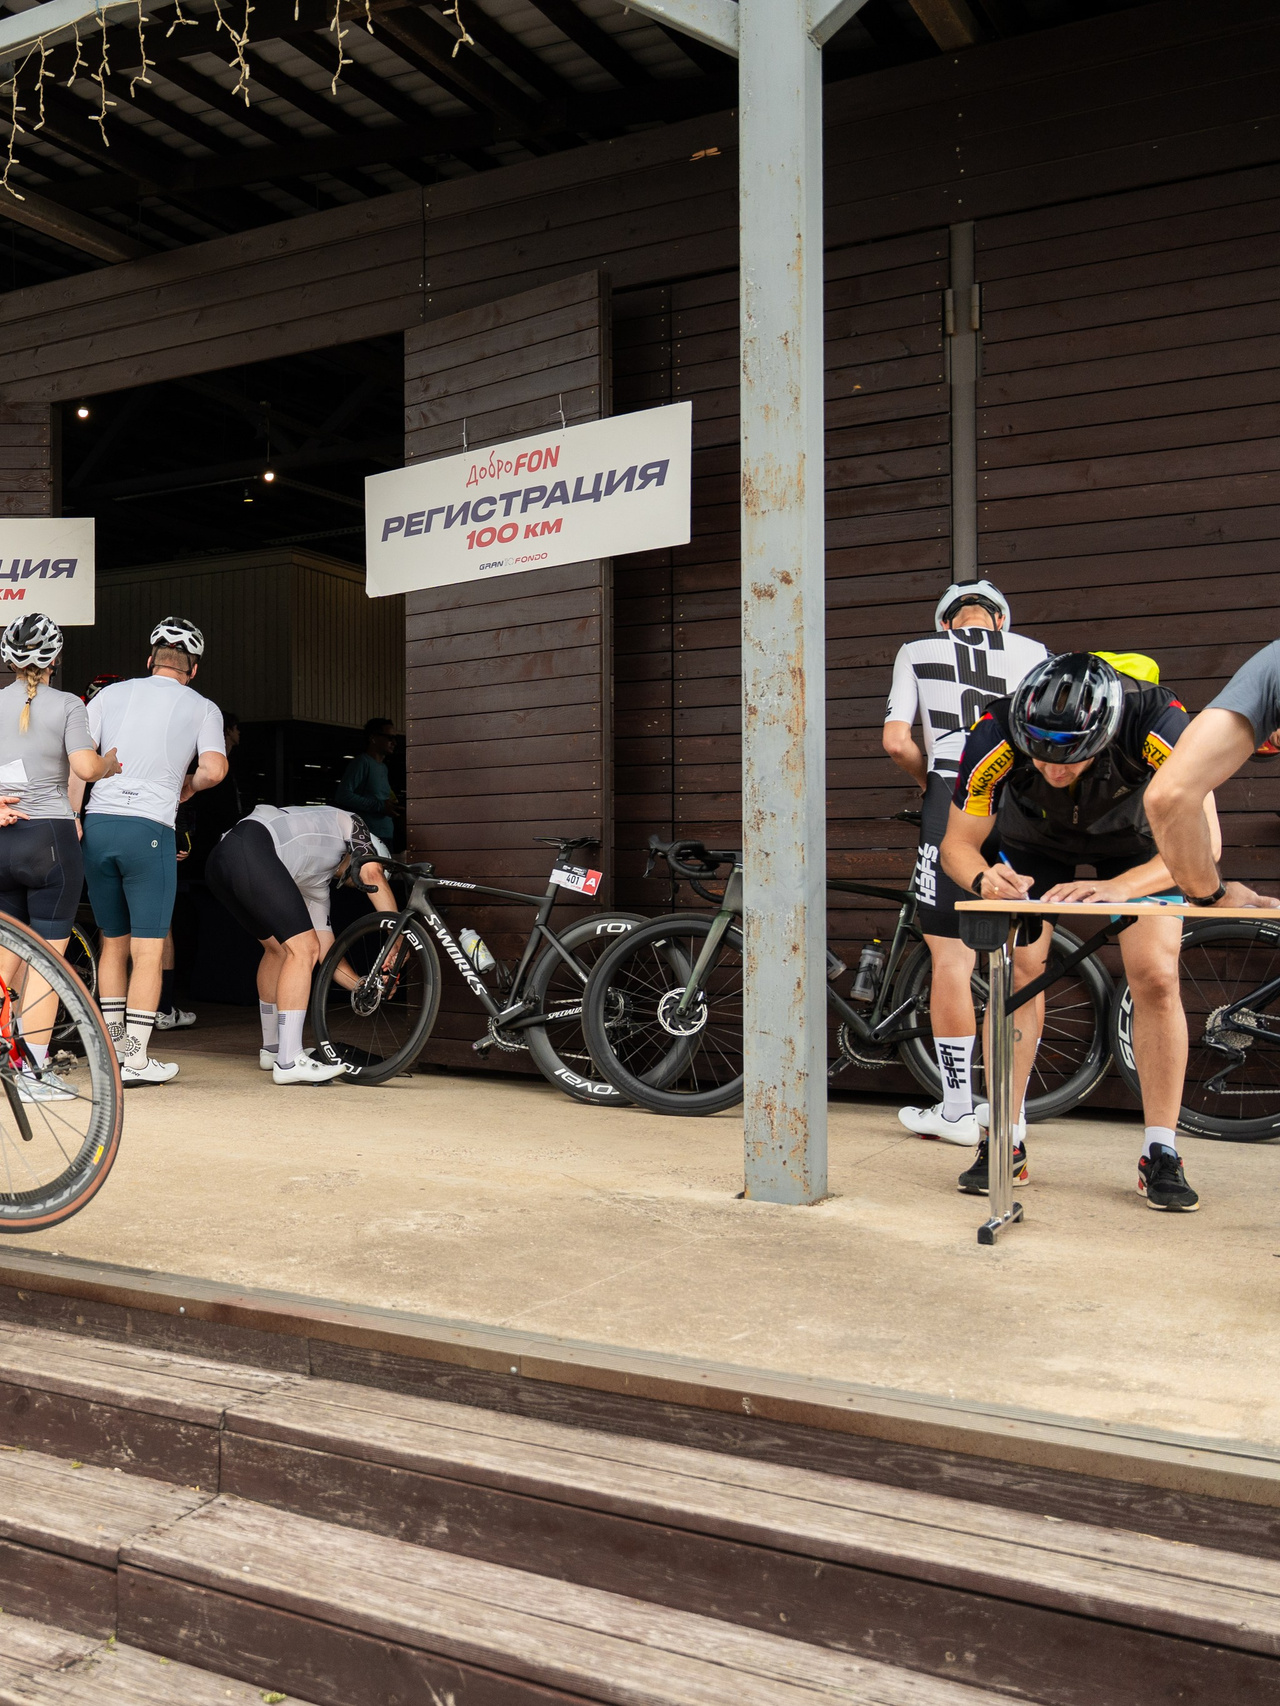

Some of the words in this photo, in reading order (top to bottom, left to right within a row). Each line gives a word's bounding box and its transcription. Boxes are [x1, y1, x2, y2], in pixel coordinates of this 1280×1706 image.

[380, 459, 670, 542] РЕГИСТРАЦИЯ
[466, 522, 519, 550] 100
[515, 552, 548, 564] FONDO
[566, 874, 580, 885] 401
[585, 877, 596, 888] A
[424, 914, 488, 996] S-WORKS
